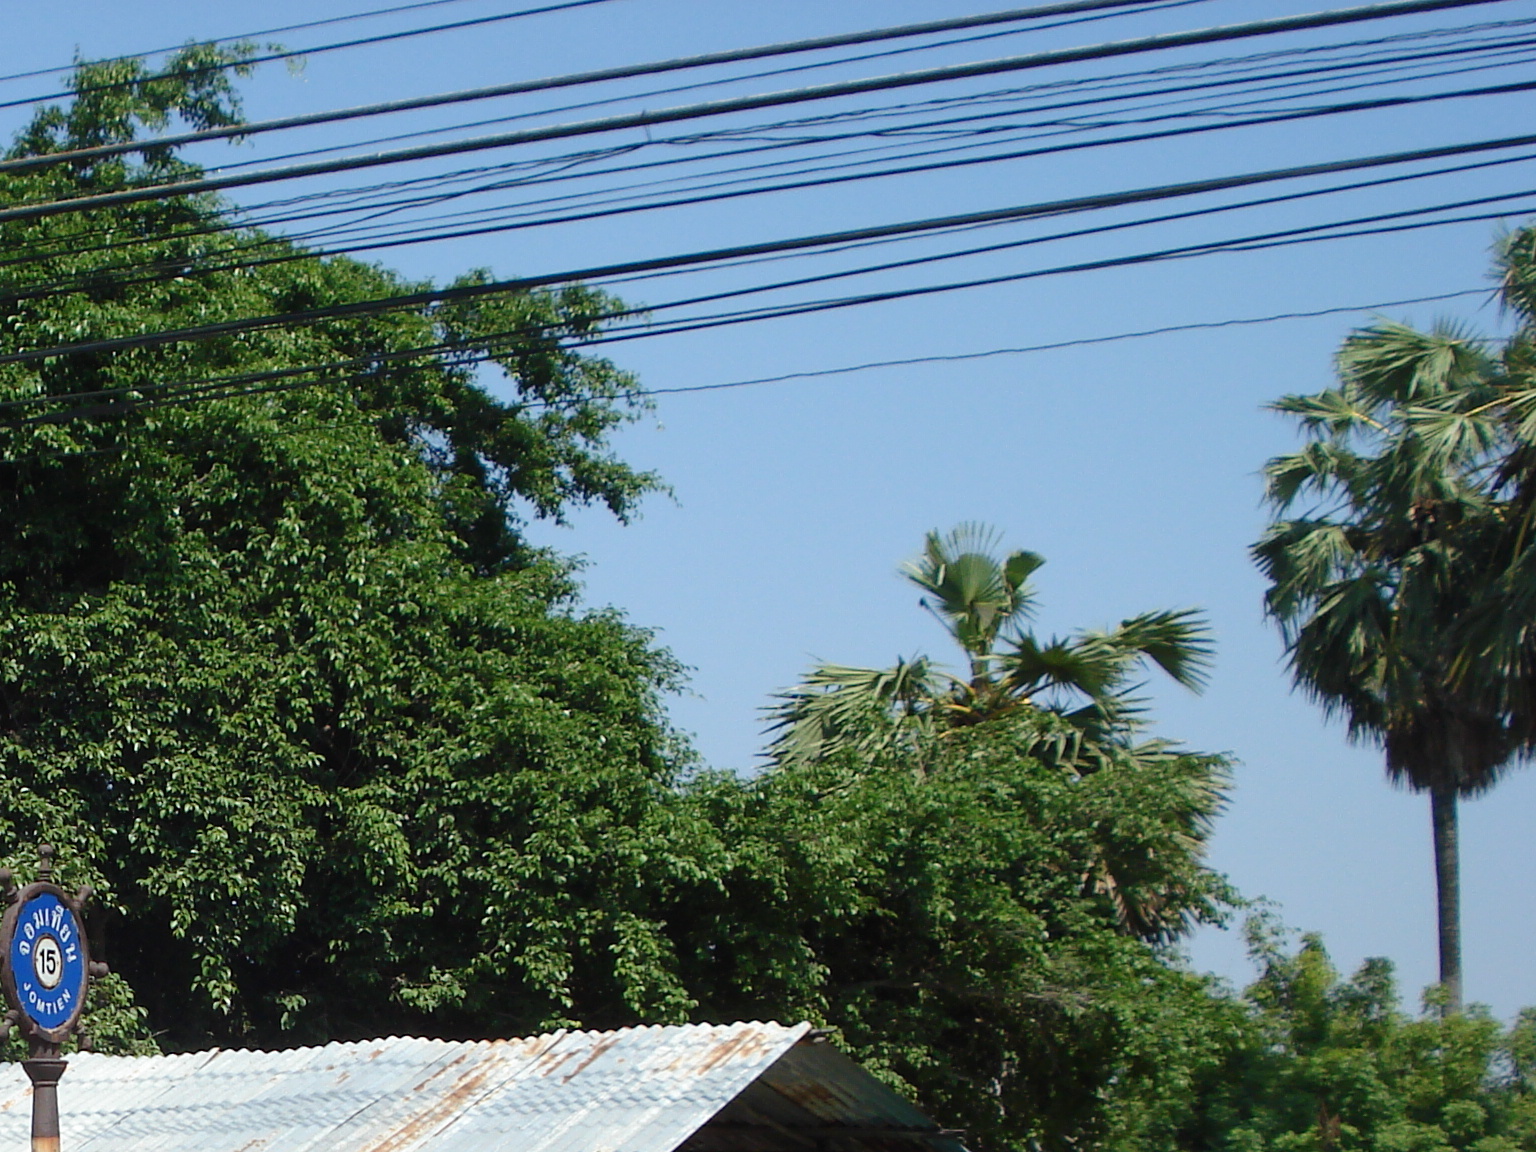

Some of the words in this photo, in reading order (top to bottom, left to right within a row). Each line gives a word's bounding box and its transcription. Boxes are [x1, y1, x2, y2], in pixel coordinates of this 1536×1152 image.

[19, 904, 77, 963] จอมเทียน
[39, 948, 57, 974] 15
[23, 982, 71, 1015] JOMTIEN
